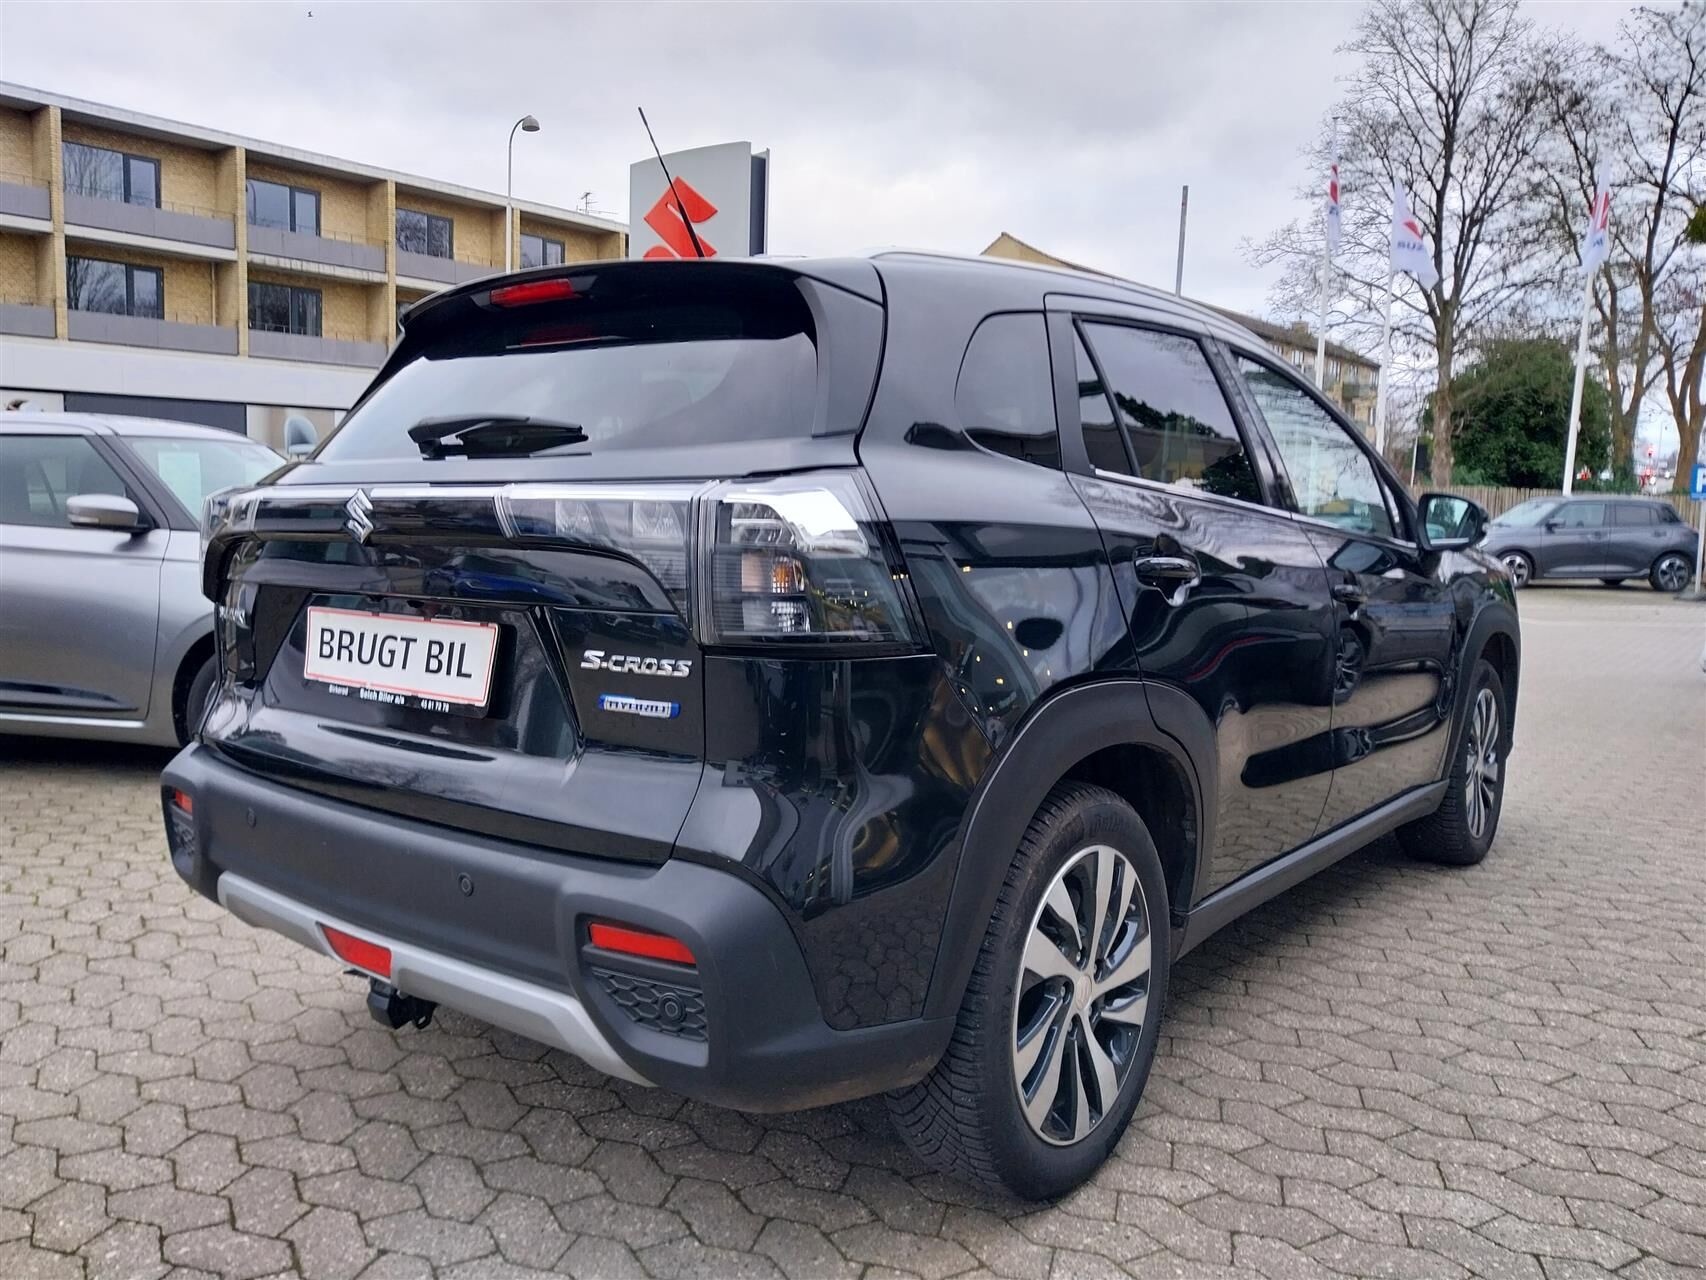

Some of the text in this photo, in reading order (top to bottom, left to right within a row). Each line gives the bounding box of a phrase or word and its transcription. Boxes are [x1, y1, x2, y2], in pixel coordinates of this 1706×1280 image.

[319, 627, 473, 679] BRUGT BIL
[608, 700, 666, 713] HYBRID
